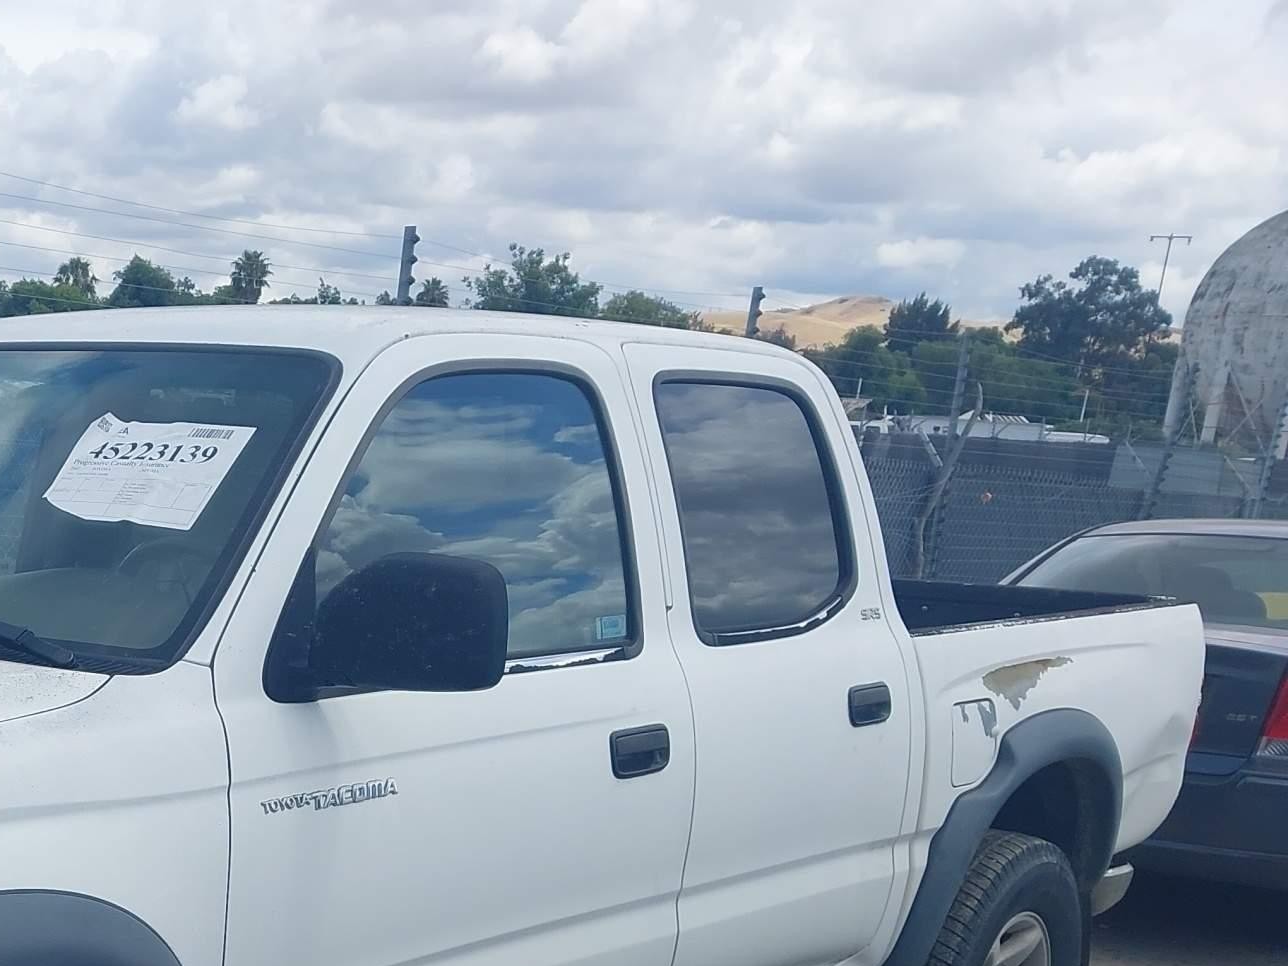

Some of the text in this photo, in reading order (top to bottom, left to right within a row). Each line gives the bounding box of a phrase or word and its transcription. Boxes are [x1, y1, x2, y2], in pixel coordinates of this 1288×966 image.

[88, 441, 219, 464] 45223139
[139, 461, 170, 470] Isurance
[260, 776, 399, 815] TOYOTA TACOMA
